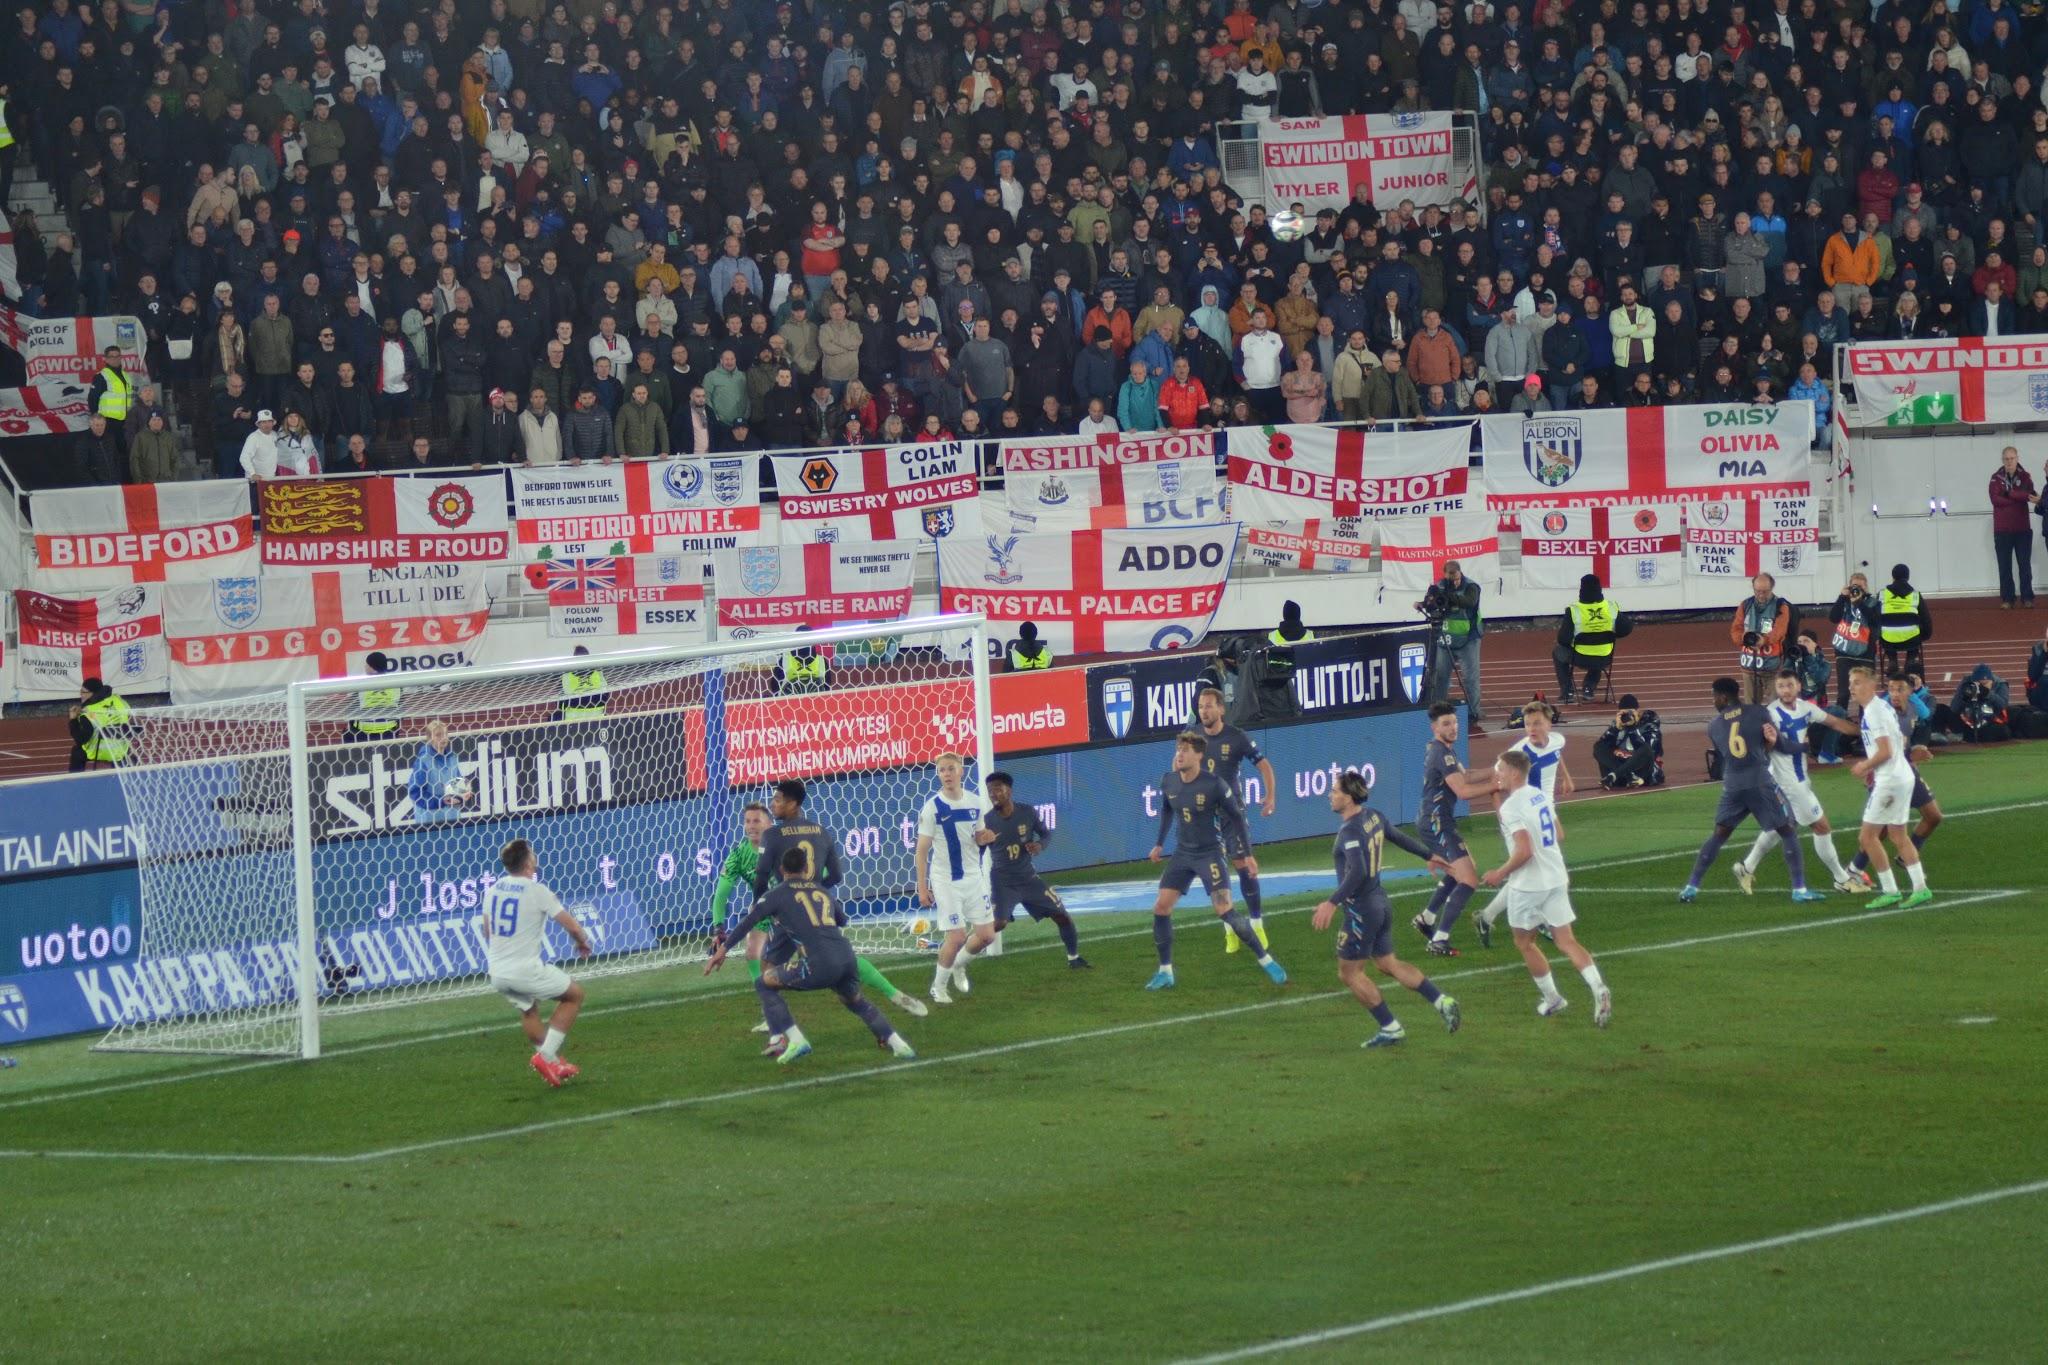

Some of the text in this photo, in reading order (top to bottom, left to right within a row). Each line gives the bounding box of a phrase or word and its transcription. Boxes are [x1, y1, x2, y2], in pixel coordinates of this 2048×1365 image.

[1280, 120, 1321, 131] SAM
[1268, 132, 1448, 165] SWINDON TOWN
[1274, 182, 1340, 198] TIYLER
[1379, 172, 1449, 191] JUNIOR
[53, 325, 69, 334] OF
[1855, 347, 2048, 372] SWINDO
[1704, 407, 1780, 428] DAISY
[1526, 426, 1578, 439] ALBION
[1700, 434, 1781, 453] OLIVIA
[900, 442, 963, 465] COLIN
[1008, 434, 1212, 471] ASHINGTON
[908, 460, 957, 481] LIAM
[1719, 459, 1767, 478] MIA
[524, 479, 613, 492] BEDFORD TOWN IS LIFE
[1244, 463, 1451, 503] ALDERSHOT
[521, 494, 620, 507] THE REST IS JUST DETAILS
[784, 480, 974, 515] OSWESTRY WOLVES
[1774, 500, 1806, 510] TARN
[1412, 503, 1430, 515] OF
[1434, 499, 1463, 512] THE
[1781, 510, 1798, 518] ON
[537, 509, 742, 541] BEDFORD TOWN F.C.
[1340, 523, 1354, 531] ON
[1773, 518, 1806, 528] TOUR
[1257, 530, 1361, 556] EADEN'S REDS
[1332, 530, 1359, 539] TOUR
[1689, 529, 1815, 544] EADEN'S REDS
[50, 524, 239, 565] BIDEFORD
[265, 537, 504, 561] HAMPSHIRE PROUD
[564, 543, 586, 554] LEST
[683, 537, 737, 551] FOLLOW
[1398, 543, 1483, 559] HASTINGS UNITED
[1538, 538, 1664, 555] BEXLEY KENT
[1695, 545, 1735, 556] FRANK
[840, 556, 850, 564] WE
[851, 556, 862, 564] SEE
[863, 554, 887, 563] THINGS
[1118, 542, 1225, 572] ADDO
[1253, 548, 1293, 561] FRANKY
[1263, 558, 1281, 568] THE
[1703, 556, 1727, 564] THE
[368, 564, 459, 584] ENGLAND
[859, 565, 891, 574] NEVER SEE
[1700, 564, 1731, 574] FLAG
[363, 585, 466, 606] TILL I DIE
[584, 587, 668, 604] BENFLEET
[566, 607, 600, 615] FOLLOW
[730, 594, 905, 619] ALLESTREE RAMS
[953, 593, 1072, 616] CRYSTAL
[1080, 593, 1183, 616] PALACE
[564, 616, 603, 625] ENGLAND
[645, 609, 697, 624] ESSEX
[38, 623, 142, 647] HEREFORD
[1832, 633, 1849, 651] 071
[958, 702, 1066, 744] puamusta
[1728, 721, 1747, 759] 6
[827, 740, 908, 767] KUMPPANI
[1207, 758, 1215, 773] 9
[1182, 807, 1192, 823] 5
[781, 825, 821, 837] BELLINGHAM
[1539, 806, 1555, 848] 9
[1006, 844, 1021, 861] 19
[1209, 862, 1221, 879] 5
[491, 895, 519, 938] 19
[795, 890, 836, 927] 12
[21, 922, 132, 968] uotoo
